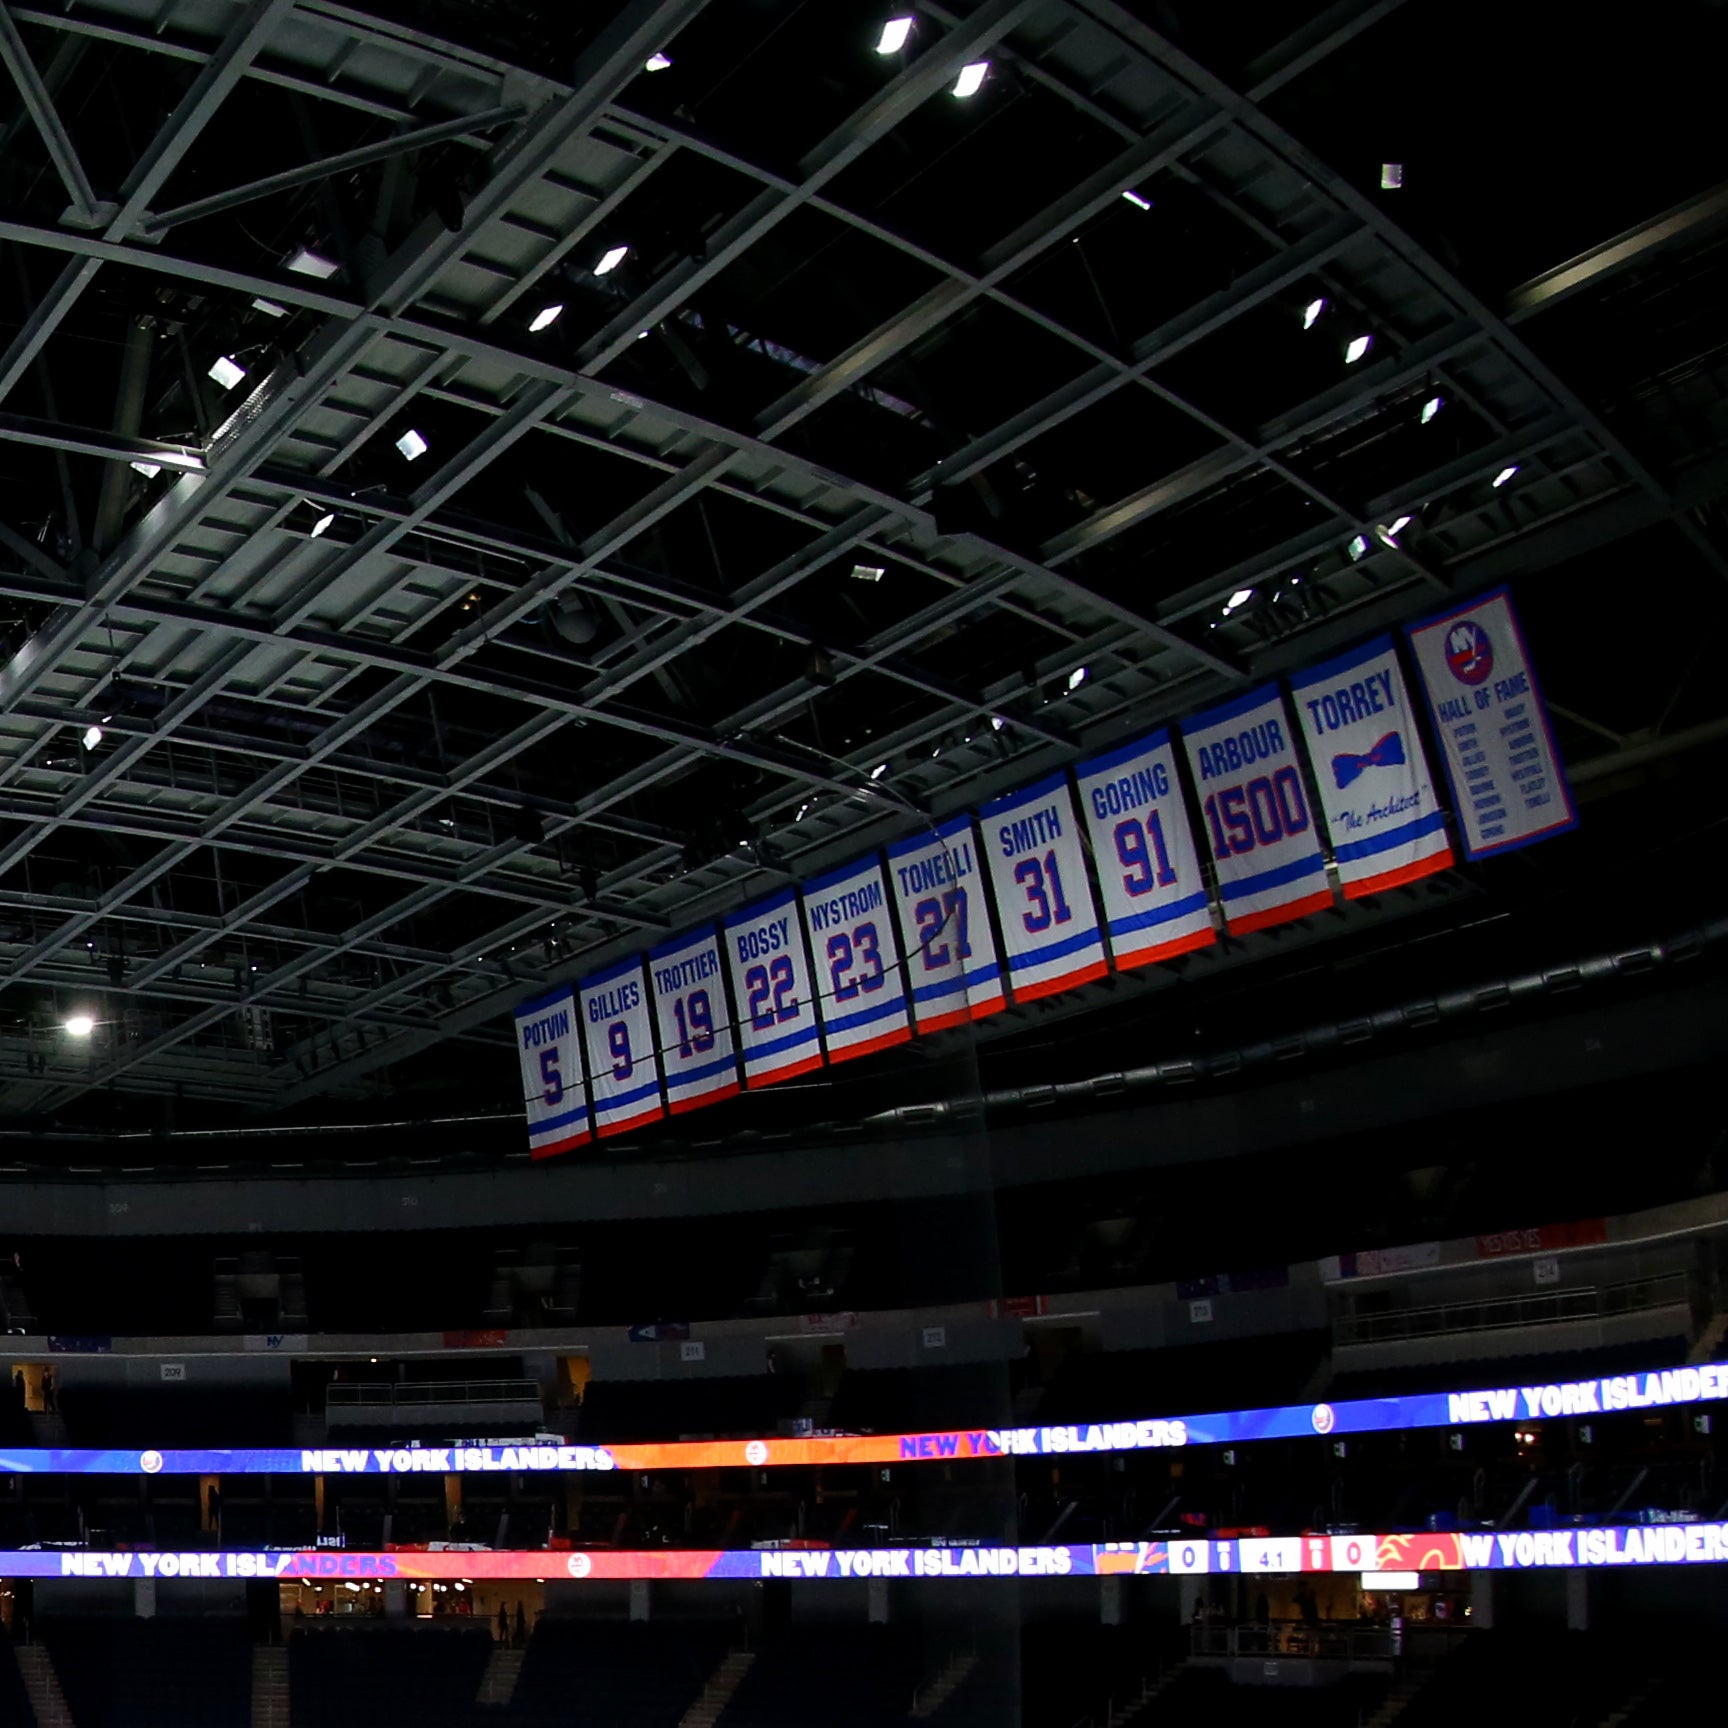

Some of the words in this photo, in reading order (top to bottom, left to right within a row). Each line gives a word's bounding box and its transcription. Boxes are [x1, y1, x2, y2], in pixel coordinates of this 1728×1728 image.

[1306, 669, 1395, 735] TORREY
[1438, 694, 1472, 723] HALL
[1474, 687, 1490, 710] OF
[1494, 671, 1530, 703] FAME
[1198, 719, 1285, 780] ARBOUR
[1091, 763, 1170, 820] GORING
[1204, 765, 1309, 860] 1500
[999, 805, 1062, 857] SMITH
[1113, 809, 1178, 898] 91
[897, 843, 972, 897] TONELLI
[1014, 849, 1072, 934] 31
[810, 880, 882, 931] NYSTROM
[915, 886, 972, 971] 27
[737, 918, 790, 963] BOSSY
[826, 922, 885, 1003] 23
[655, 949, 718, 995] TROTTIER
[745, 954, 800, 1031] 22
[588, 981, 640, 1023] GILLIES
[673, 989, 714, 1059] 19
[523, 1009, 569, 1050] POTVIN
[608, 1021, 632, 1081] 9
[540, 1046, 563, 1106] 5
[164, 1367, 181, 1377] 209
[1448, 1388, 1517, 1424] NEW
[1521, 1381, 1597, 1418] YORK
[900, 1435, 964, 1459] NEW
[969, 1428, 1037, 1456] YORK
[1042, 1420, 1187, 1453] ISLANDERS
[60, 1553, 134, 1576] NEW
[139, 1553, 220, 1575] YORK
[226, 1553, 397, 1576] ISLANDERS
[761, 1551, 831, 1577] NEW
[836, 1549, 910, 1577] YORK
[914, 1546, 1072, 1576] ISLANDERS
[1182, 1546, 1195, 1568] 0
[1259, 1550, 1283, 1568] 4.1
[1347, 1542, 1361, 1565] 0
[1496, 1533, 1572, 1567] YORK
[1576, 1523, 1728, 1567] ISLANDERS
